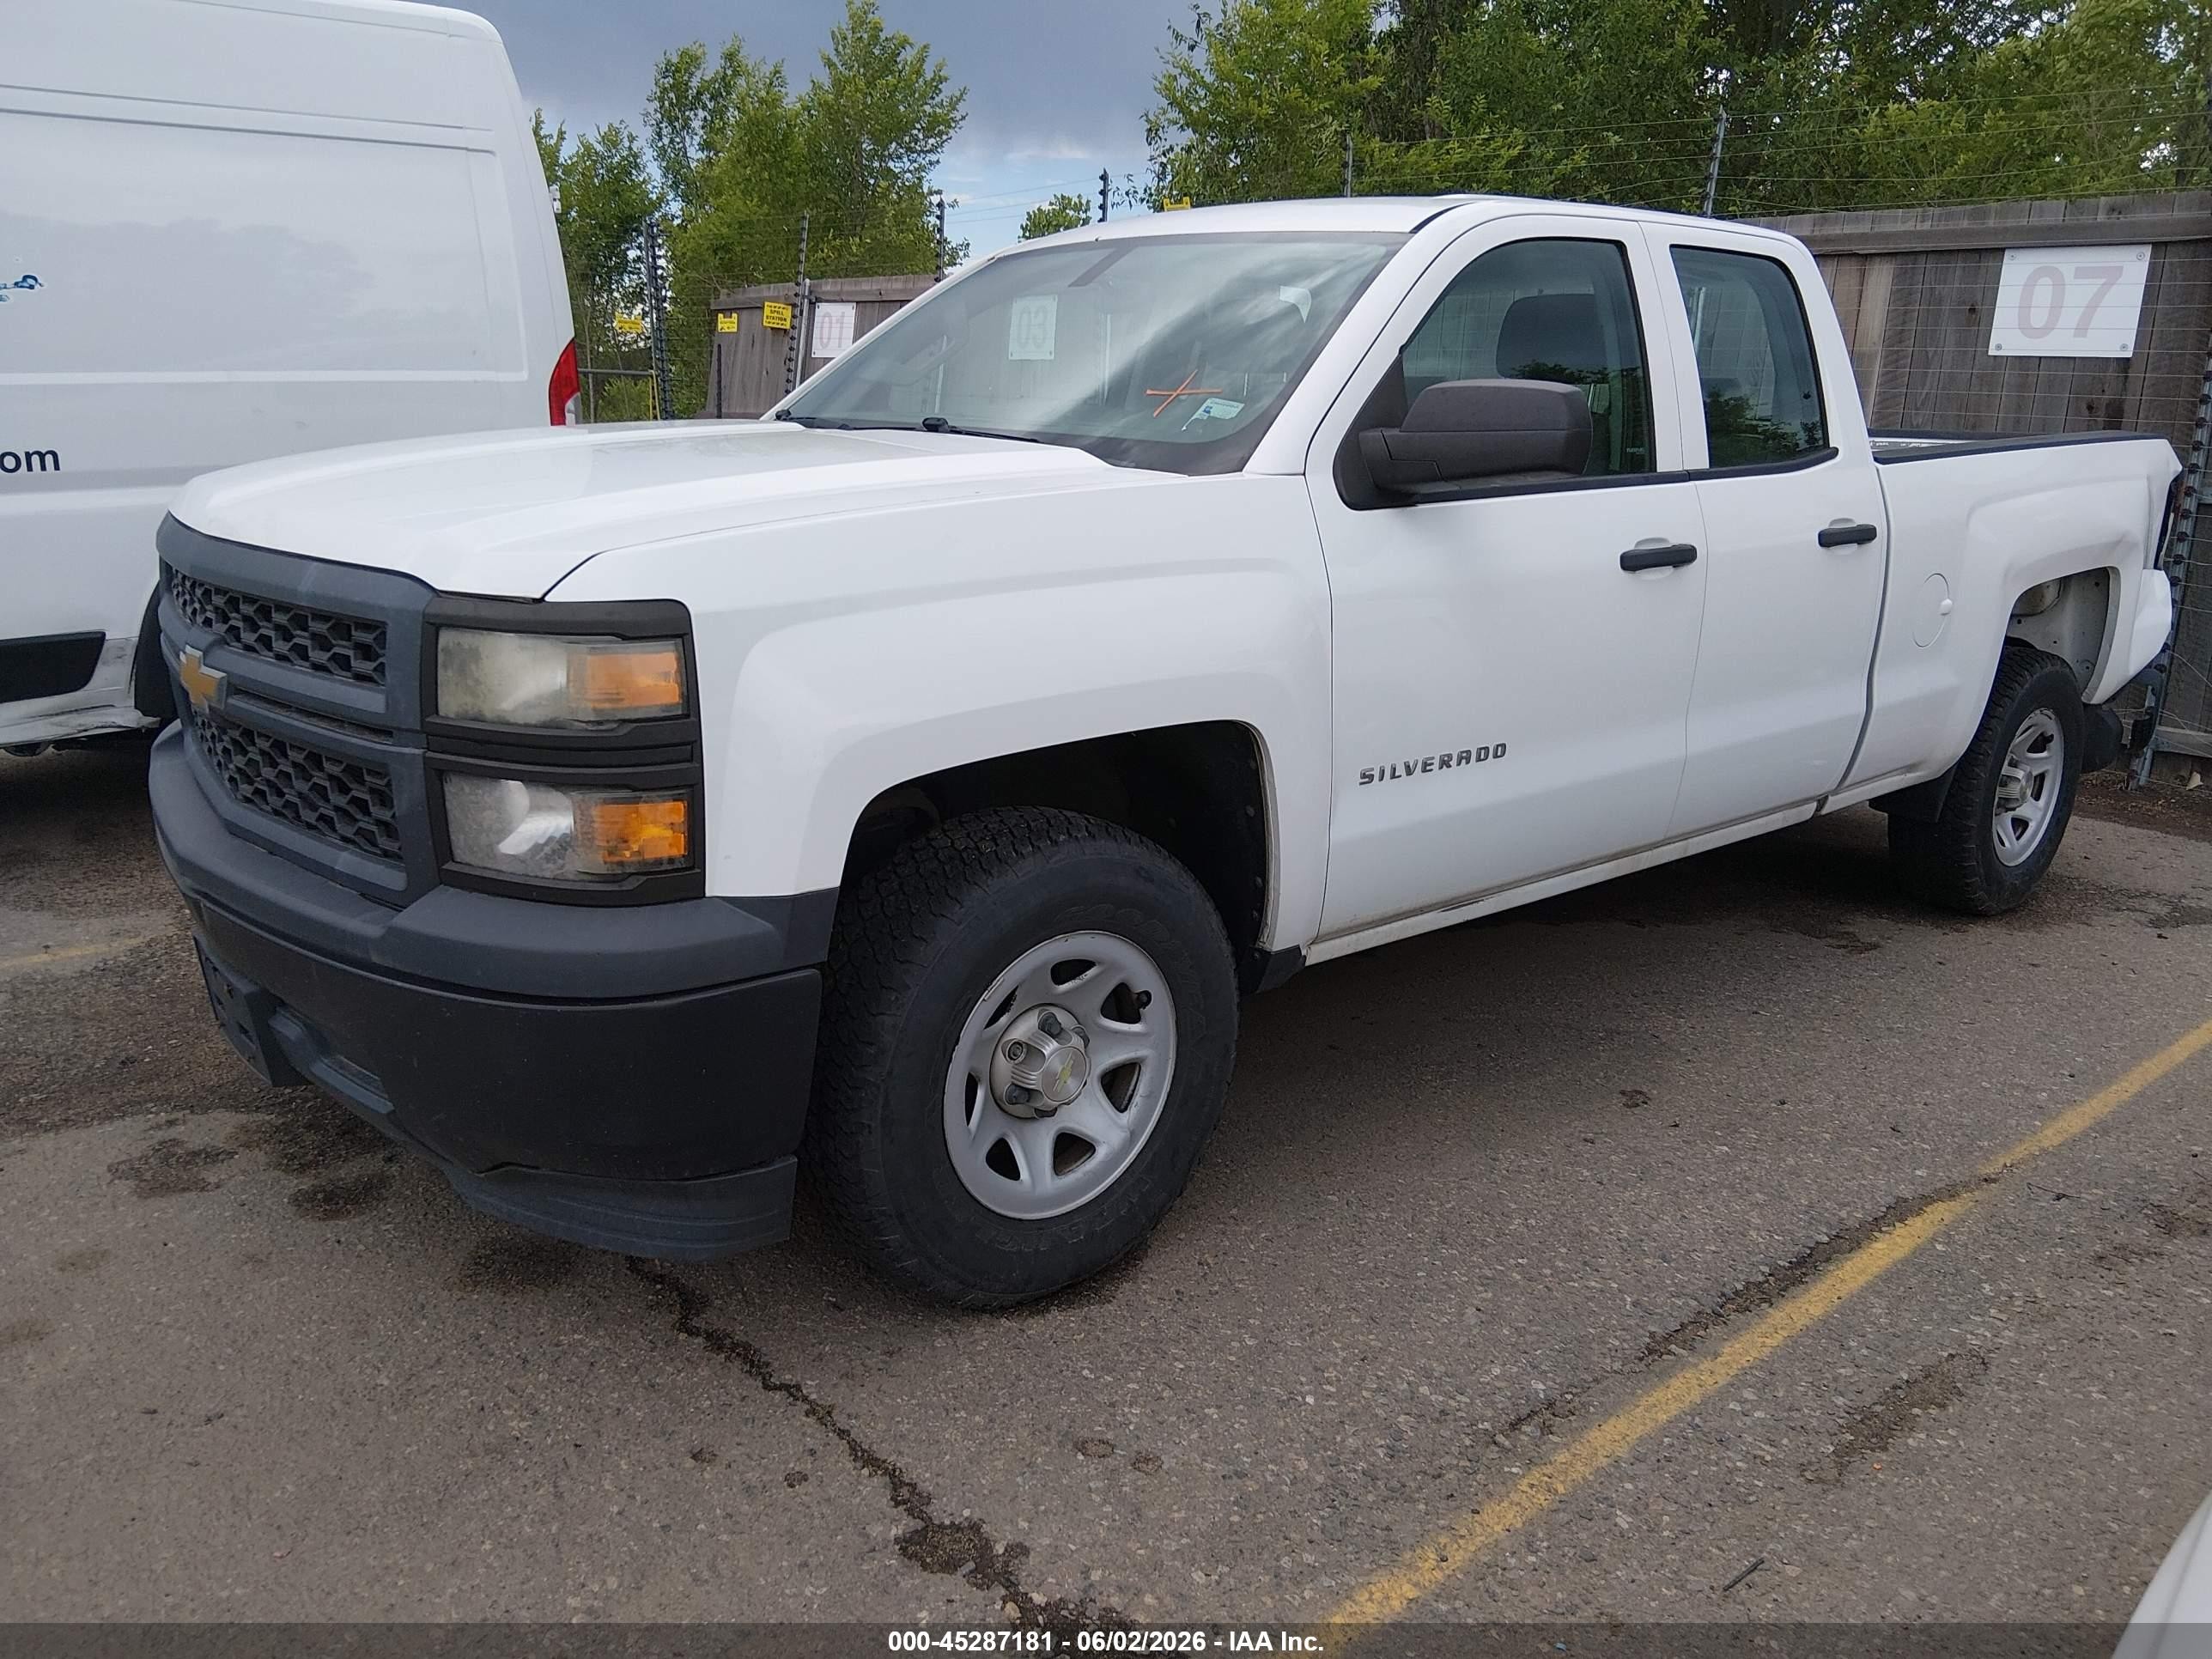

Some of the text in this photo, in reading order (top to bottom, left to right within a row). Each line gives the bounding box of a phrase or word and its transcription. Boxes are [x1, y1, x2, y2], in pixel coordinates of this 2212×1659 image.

[2019, 265, 2124, 339] 07
[819, 311, 845, 349] 01
[1358, 743, 1507, 786] SILVERADO
